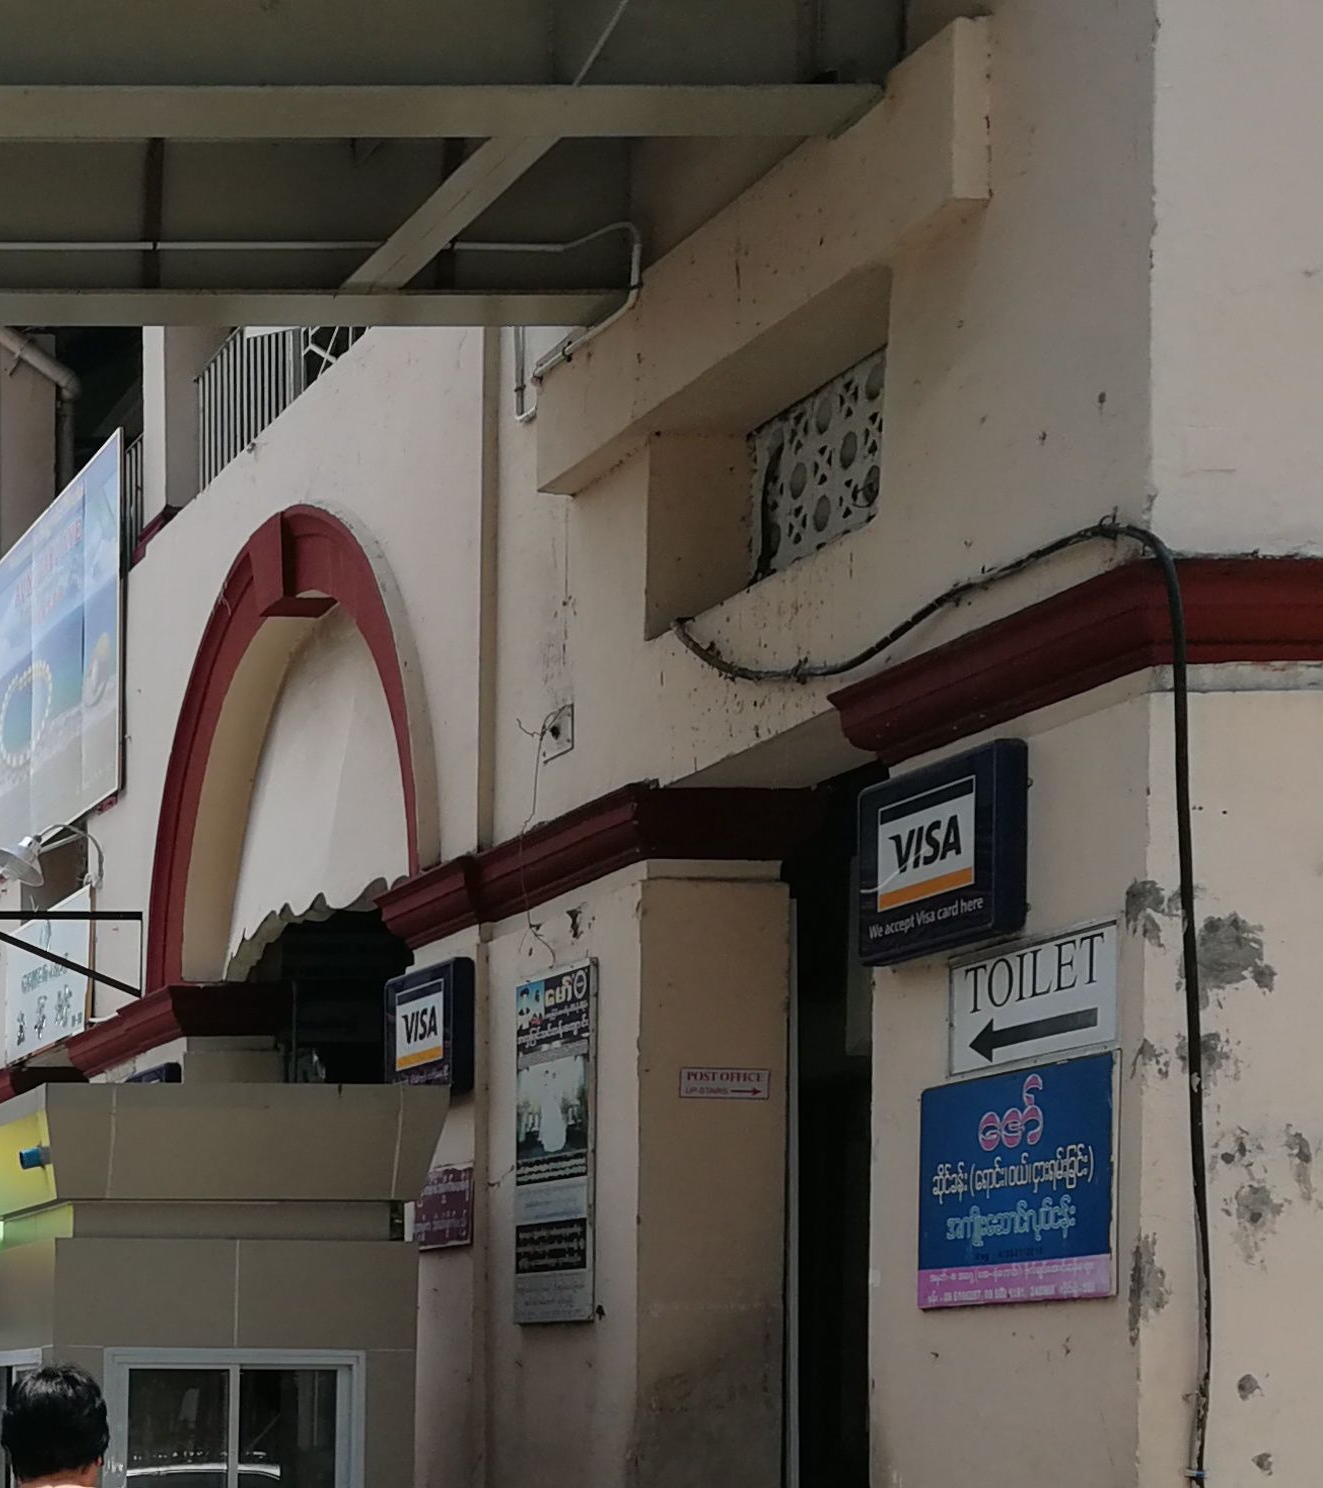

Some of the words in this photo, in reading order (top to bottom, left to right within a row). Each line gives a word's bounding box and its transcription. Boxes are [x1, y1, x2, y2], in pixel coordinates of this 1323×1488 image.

[888, 814, 962, 875] VISA
[868, 923, 883, 940] We
[884, 914, 915, 935] accept
[915, 910, 936, 928] Visa
[937, 903, 959, 922] card
[960, 897, 984, 915] here
[964, 932, 1106, 1014] TOILET
[401, 1005, 438, 1045] VISA
[687, 1071, 718, 1082] POST
